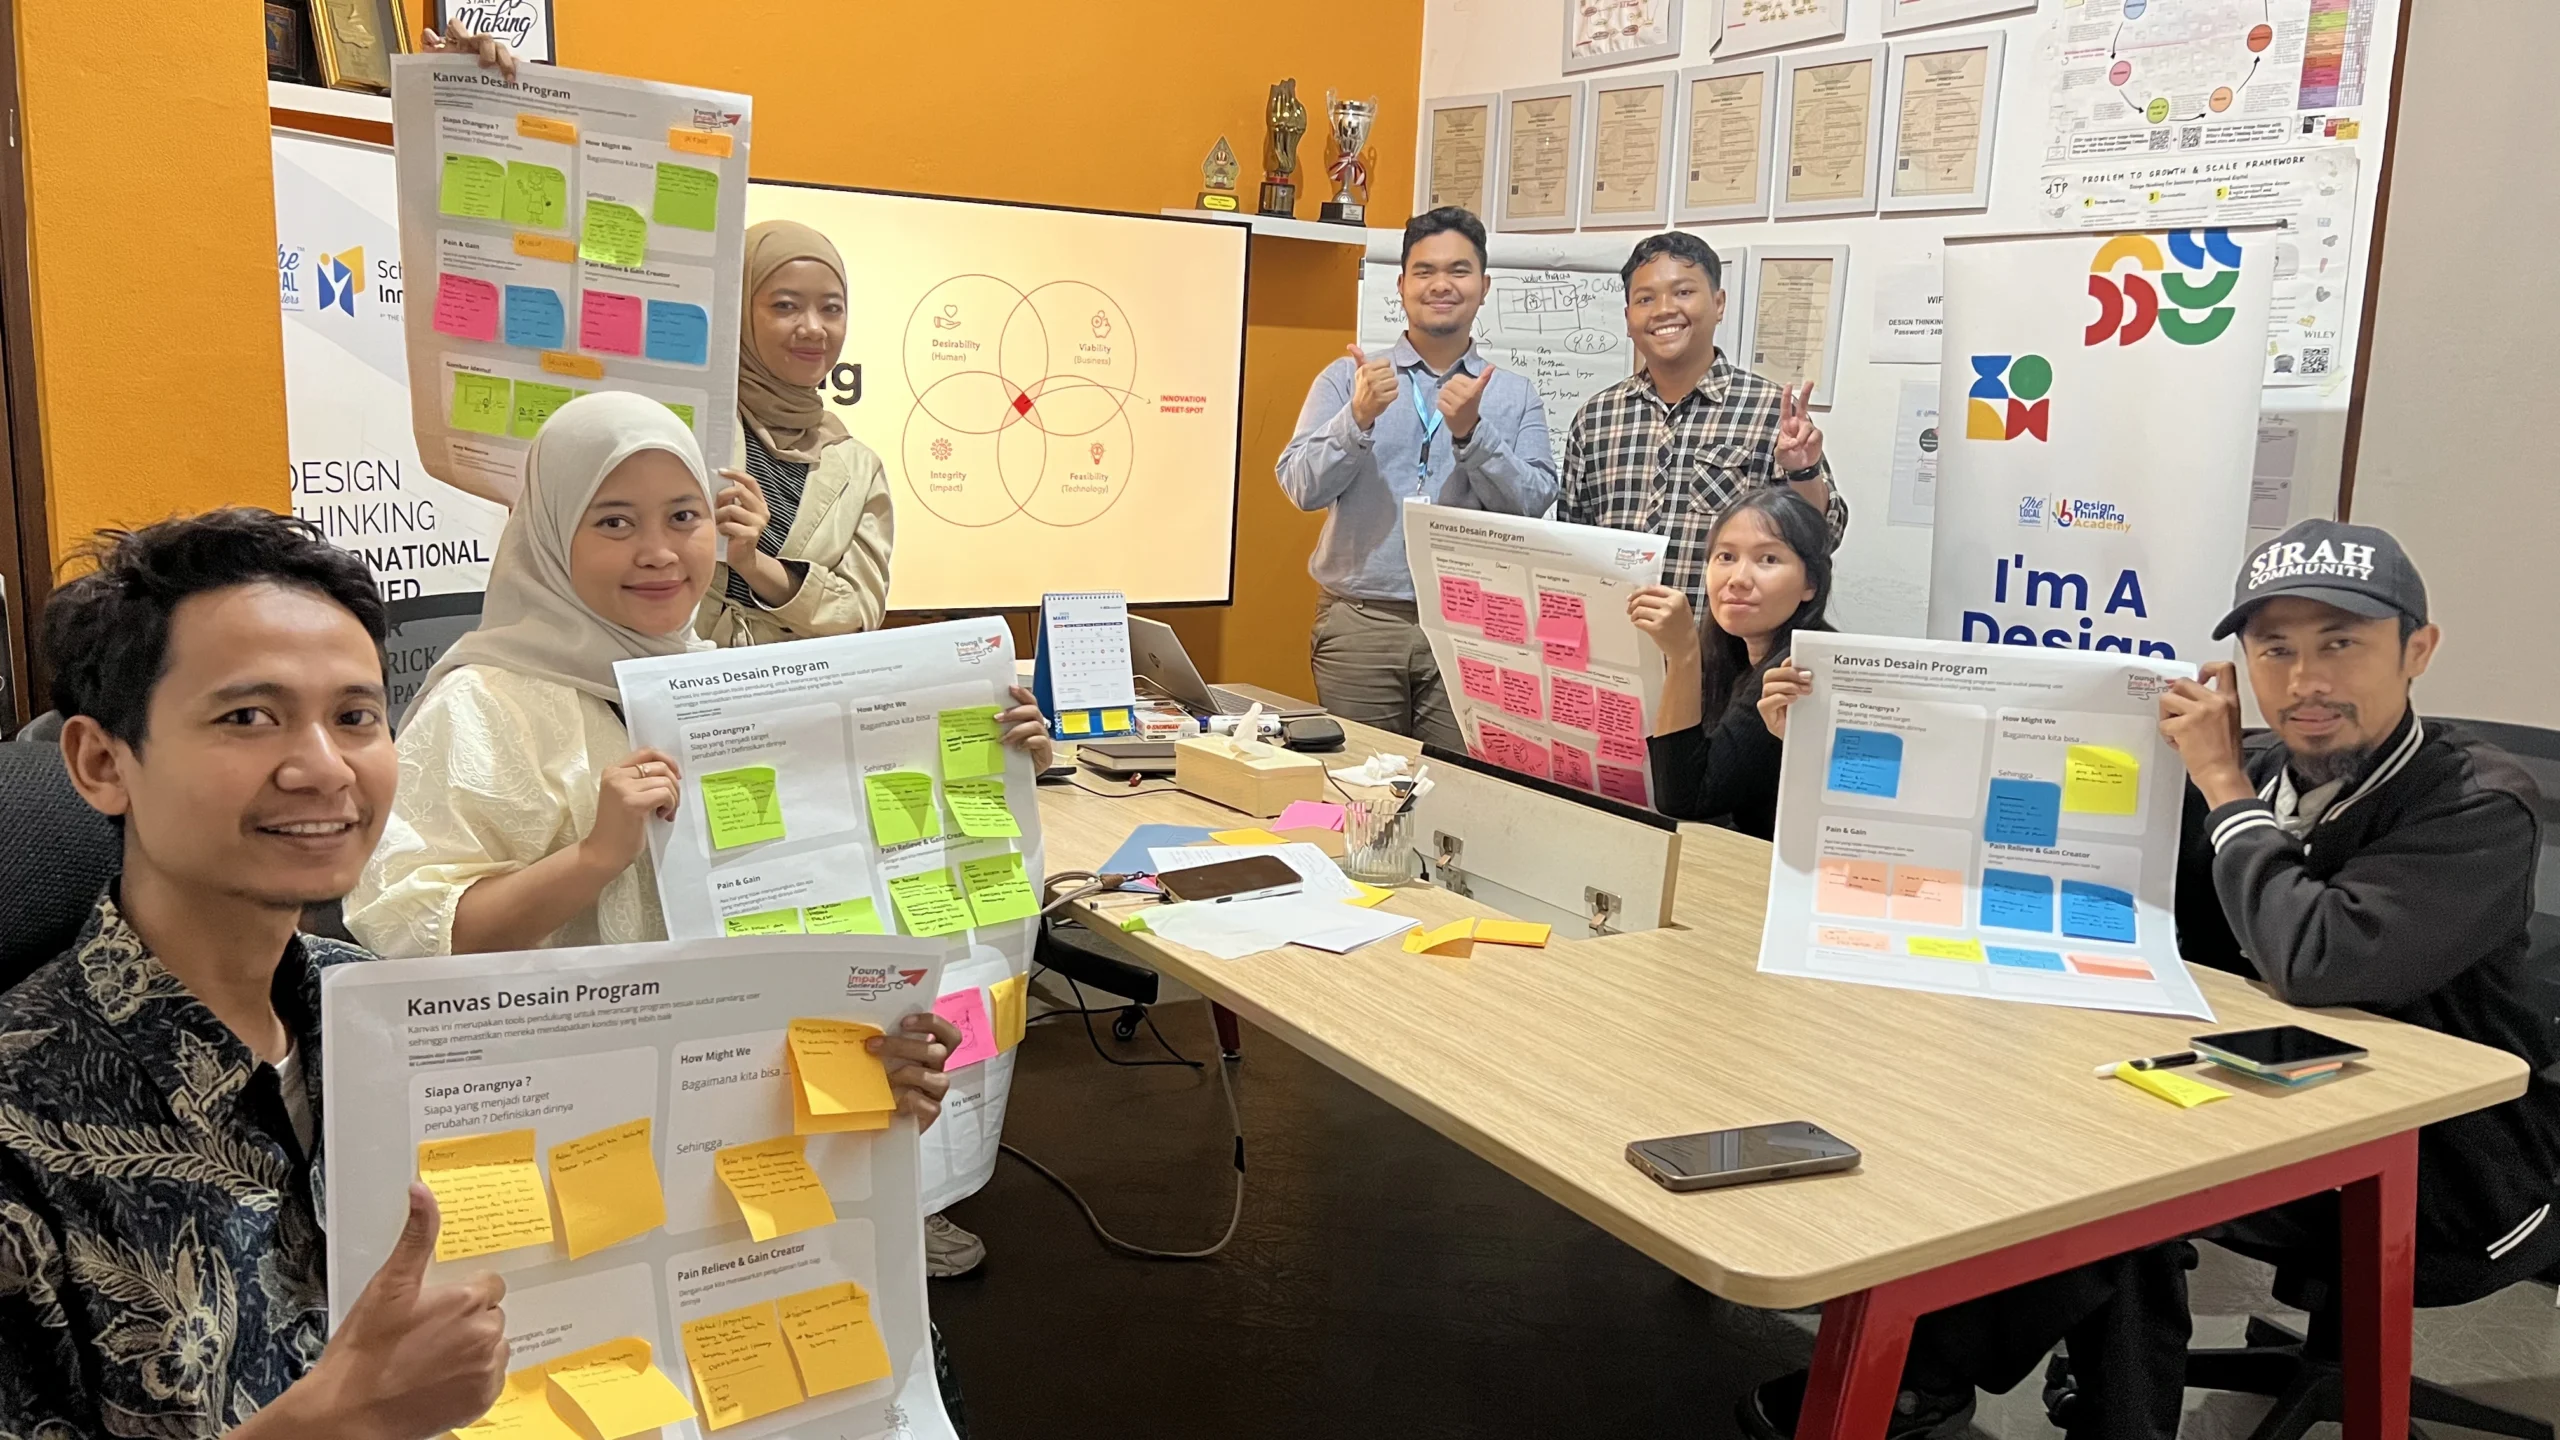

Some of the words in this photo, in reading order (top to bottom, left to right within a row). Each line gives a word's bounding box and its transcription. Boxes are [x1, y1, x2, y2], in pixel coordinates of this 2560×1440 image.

[456, 7, 531, 48] Making
[433, 72, 478, 84] Kanvas
[481, 75, 519, 90] Desain
[522, 83, 571, 100] Program
[2082, 174, 2124, 184] PROBLEM
[2149, 167, 2186, 178] GROWTH
[2192, 166, 2199, 174] &
[2206, 162, 2238, 173] SCALE
[2246, 156, 2306, 168] FRAMEWORK
[2304, 331, 2336, 339] WILEY
[932, 339, 980, 351] Desirability
[1079, 343, 1112, 354] Viability
[932, 352, 966, 362] (Human)
[1074, 355, 1112, 366] (Business)
[1160, 395, 1207, 403] INNOVATION
[930, 471, 967, 482] Integrity
[1070, 473, 1109, 482] Feasibility
[930, 483, 963, 493] (Impact)
[1061, 484, 1109, 495] (Technology)
[2022, 496, 2043, 509] The
[2074, 500, 2115, 511] Design
[2020, 509, 2041, 518] LOCAL
[2074, 510, 2124, 523] Thinking
[1429, 521, 1458, 533] Kanvas
[1459, 525, 1487, 537] Desain
[1489, 529, 1525, 543] Program
[2074, 519, 2131, 533] Academy
[2248, 563, 2374, 589] COMMUNITY
[1994, 554, 2089, 611] I'm
[2104, 569, 2148, 618] A
[955, 640, 978, 648] Young
[1834, 654, 1880, 668] Kanvas
[1884, 658, 1928, 671] Desain
[1931, 662, 1988, 675] Program
[669, 676, 720, 690] Kanvas
[723, 668, 770, 683] Desain
[772, 659, 829, 679] Program
[2128, 674, 2155, 683] Young
[874, 703, 894, 712] Might
[860, 719, 900, 731] Bagaimana
[902, 716, 914, 724] kita
[916, 714, 930, 722] bisa
[689, 731, 711, 740] Siapa
[713, 725, 750, 738] Orangnya
[2002, 731, 2045, 740] Bagaimana
[2047, 734, 2062, 742] kita
[2064, 735, 2080, 743] bisa
[864, 762, 896, 774] Sehingga
[1998, 770, 2034, 780] Sehingga
[1826, 826, 1841, 834] Pain
[898, 840, 922, 851] Relieve
[1989, 843, 2005, 852] Pain
[2035, 847, 2042, 855] &
[2043, 848, 2060, 857] Gain
[2062, 850, 2090, 860] Creator
[717, 881, 734, 890] Pain
[743, 875, 760, 884] Gain
[850, 966, 886, 976] Young
[849, 974, 886, 984] Impact
[407, 997, 491, 1017] Kanvas
[498, 987, 570, 1009] Desain
[576, 980, 660, 1004] Program
[407, 1025, 440, 1034] Kanvas
[441, 1023, 452, 1031] ini
[454, 1018, 503, 1031] merupakan
[505, 1015, 526, 1026] tools
[527, 1010, 572, 1025] pendukung
[573, 1009, 595, 1018] untuk
[640, 1001, 671, 1012] program
[408, 1036, 448, 1048] sehingga
[450, 1031, 502, 1044] memastikan
[504, 1027, 535, 1038] mereka
[536, 1022, 591, 1036] mendapatkan
[680, 1054, 703, 1064] How
[706, 1050, 733, 1063] Might
[735, 1047, 751, 1056] We
[681, 1075, 738, 1091] Bagaimana
[740, 1071, 758, 1081] kita
[761, 1067, 780, 1078] bisa
[425, 1087, 460, 1099] Siapa
[463, 1078, 523, 1093] Orangnya
[526, 1076, 531, 1086] ?
[424, 1104, 453, 1116] Siapa
[454, 1101, 479, 1114] yang
[481, 1095, 520, 1110] menjadi
[522, 1091, 550, 1104] target
[424, 1116, 481, 1133] perubahan
[482, 1114, 488, 1123] ?
[490, 1108, 541, 1123] Definisikan
[543, 1102, 573, 1115] dirinya
[677, 1138, 723, 1154] Sehingga
[677, 1269, 699, 1281] Pain
[701, 1258, 736, 1276] Relieve
[738, 1257, 745, 1267] &
[747, 1250, 769, 1265] Gain
[770, 1243, 806, 1259] Creator
